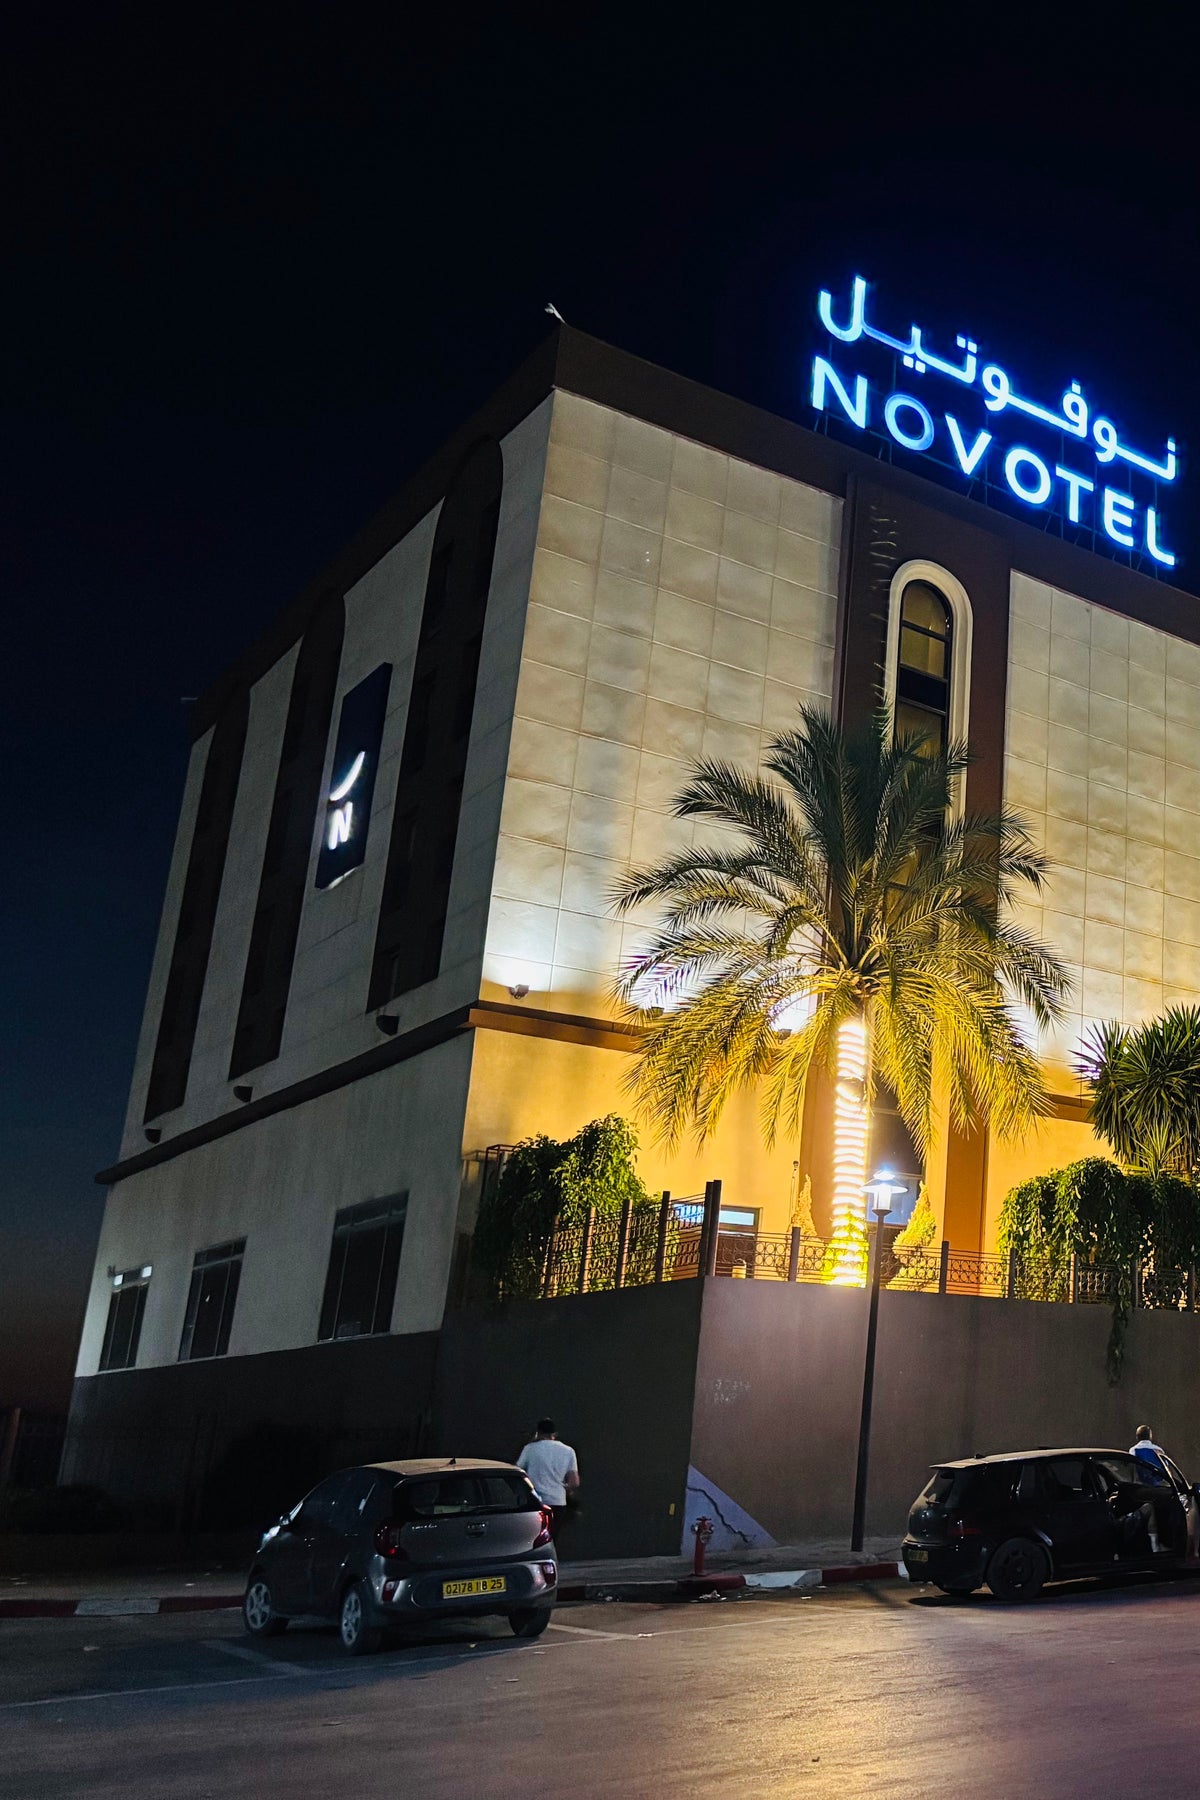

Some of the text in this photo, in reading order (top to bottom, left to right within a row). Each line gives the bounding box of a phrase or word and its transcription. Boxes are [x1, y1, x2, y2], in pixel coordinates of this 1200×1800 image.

[817, 275, 1176, 481] نوفوتيل
[811, 355, 1176, 566] NOVOTEL
[328, 801, 353, 850] N
[446, 1582, 473, 1595] 02178
[490, 1579, 503, 1590] 25
